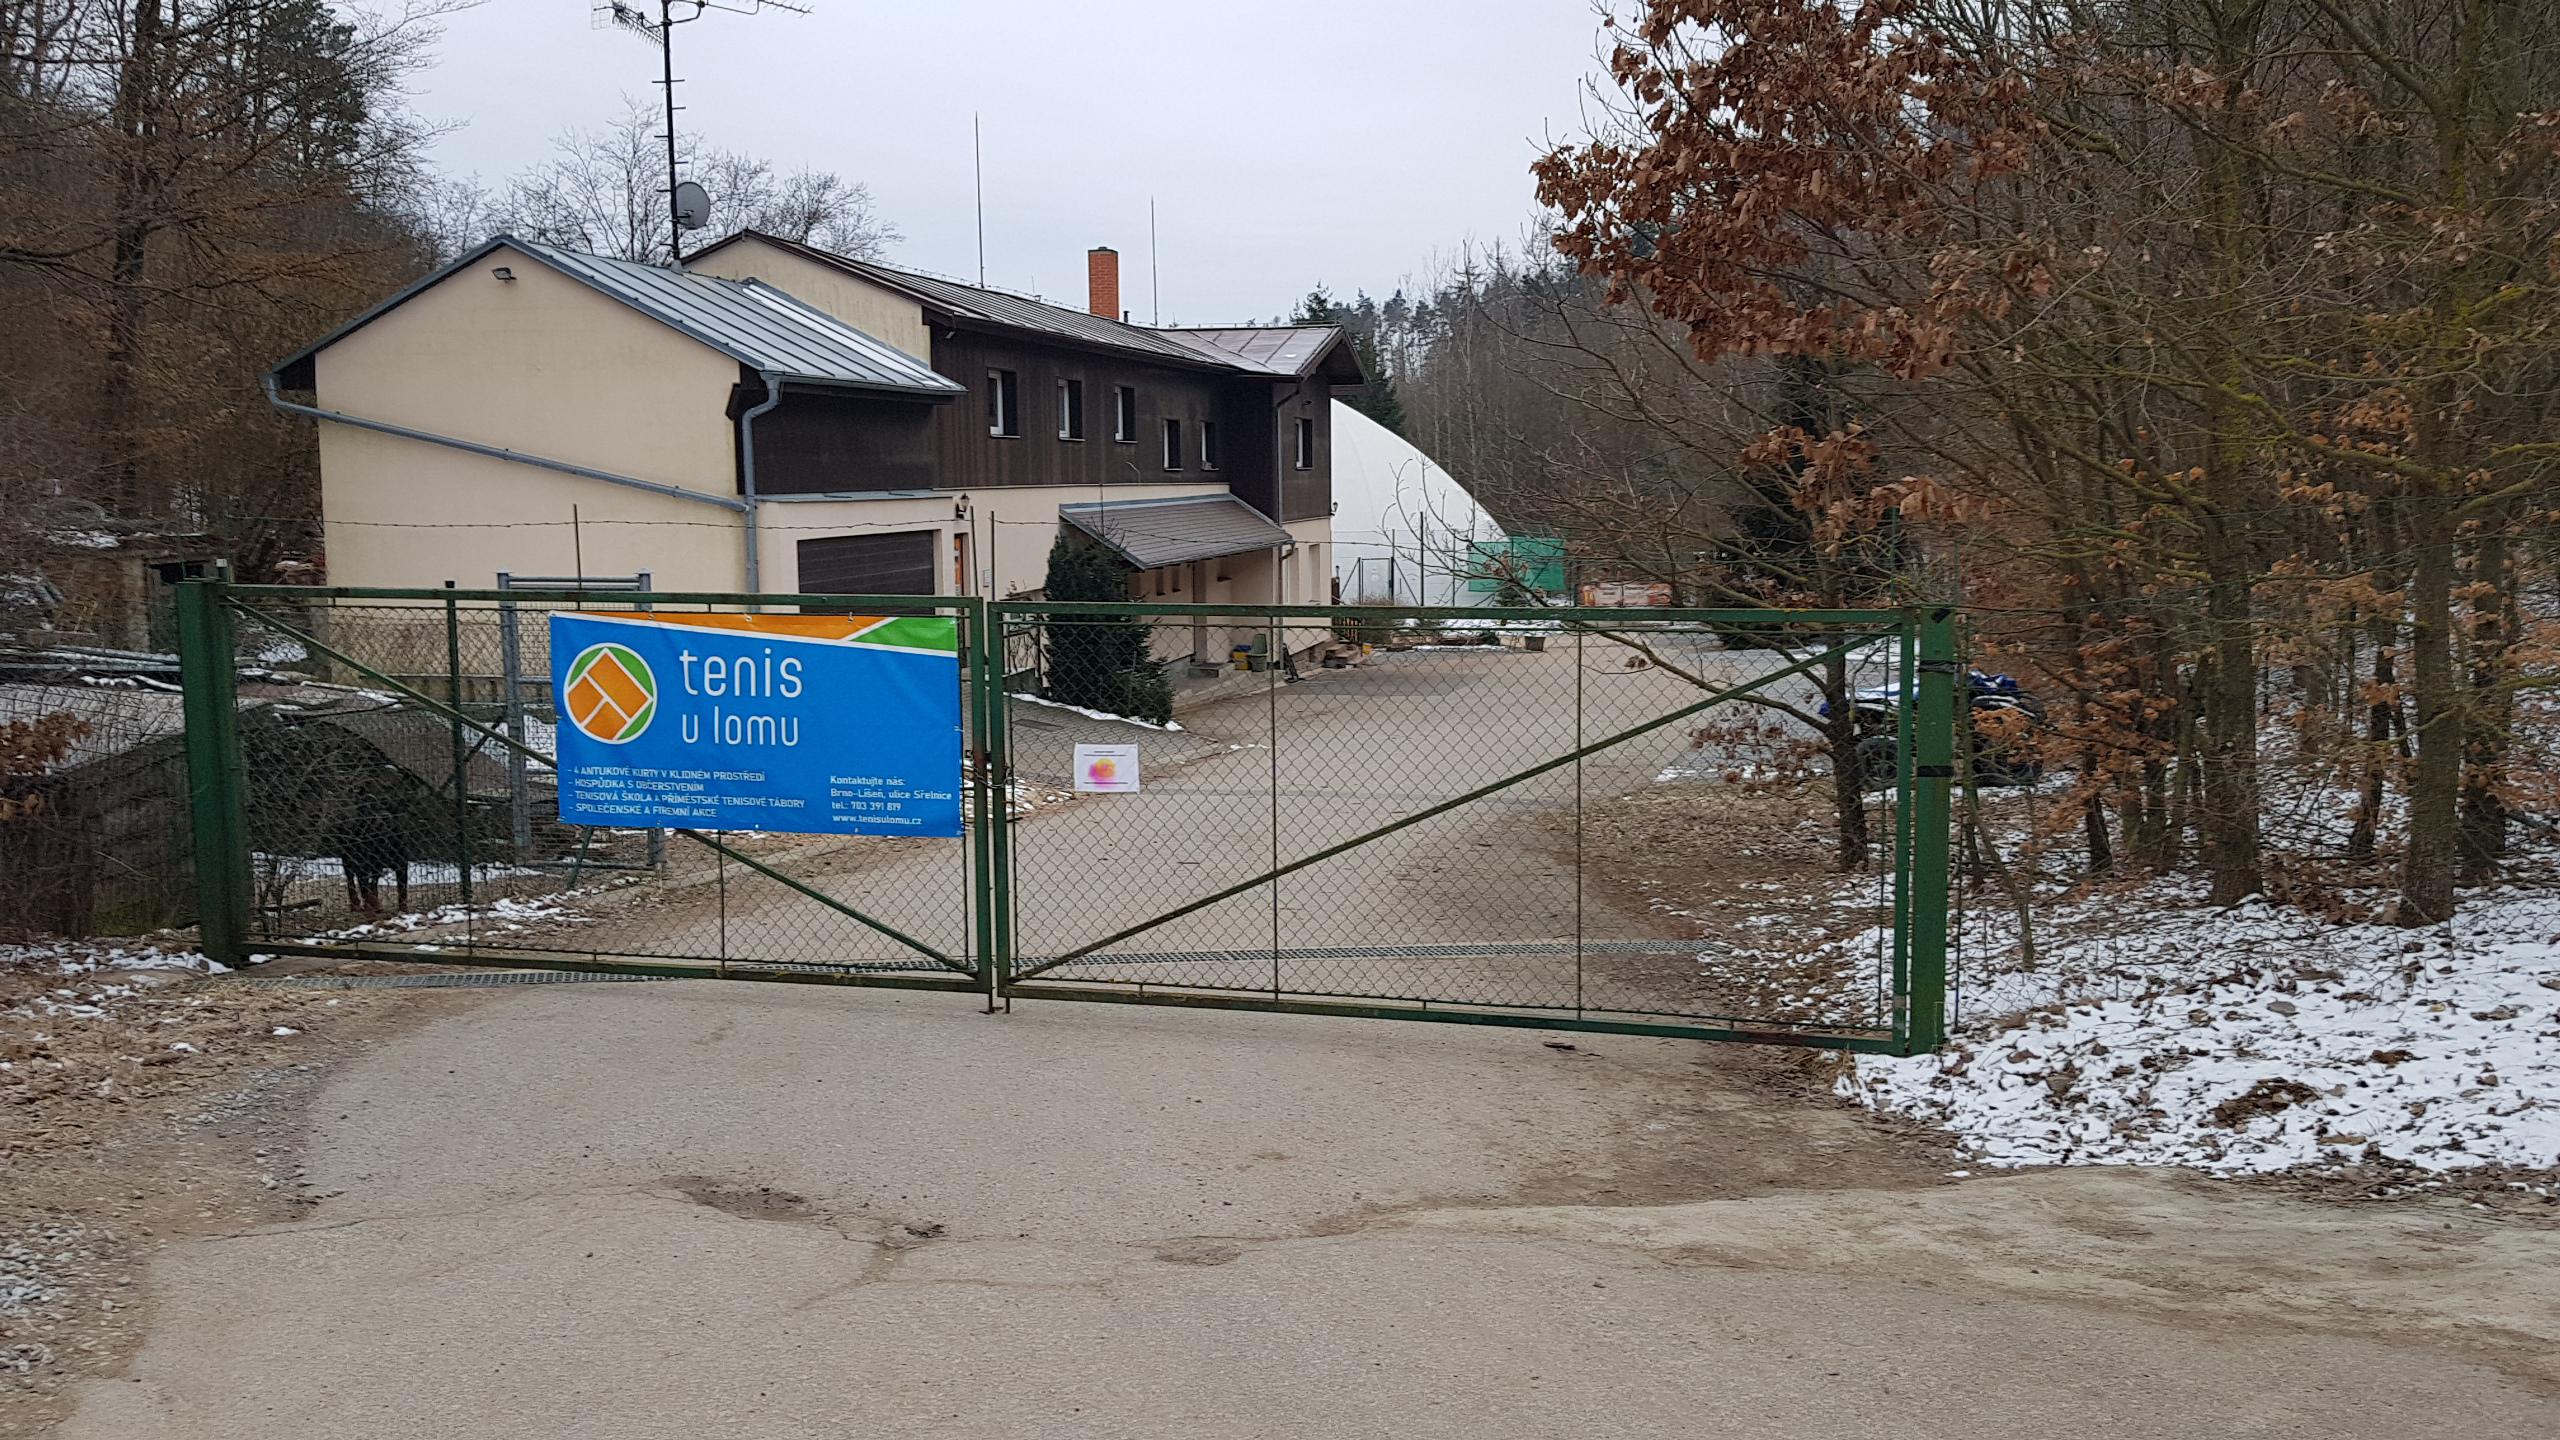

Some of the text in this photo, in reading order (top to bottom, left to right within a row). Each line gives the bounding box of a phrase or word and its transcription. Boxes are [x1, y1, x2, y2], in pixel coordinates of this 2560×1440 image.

[679, 648, 803, 698] tenis
[681, 705, 799, 746] u lomu
[581, 766, 631, 776] ANTUKOVÉ
[632, 768, 659, 777] KURTY
[660, 769, 667, 777] V
[669, 769, 711, 780] KLIDNÉM
[713, 770, 766, 782] PROSTŘEDÍ
[575, 777, 625, 788] HOSPŮDKA
[627, 780, 634, 788] S
[830, 775, 884, 787] Kontaktujte
[575, 790, 619, 801] TENISOVÁ
[621, 790, 653, 802] ŠKOLA
[722, 796, 767, 807] TENISOVÉ
[768, 797, 805, 808] TÁBORY
[888, 789, 911, 799] ulice
[575, 803, 718, 818] SPOLEČENSKÉ A FIREMNÍ AKCE
[869, 801, 885, 811] 391
[832, 813, 923, 825] www.tenisulomu.cz
